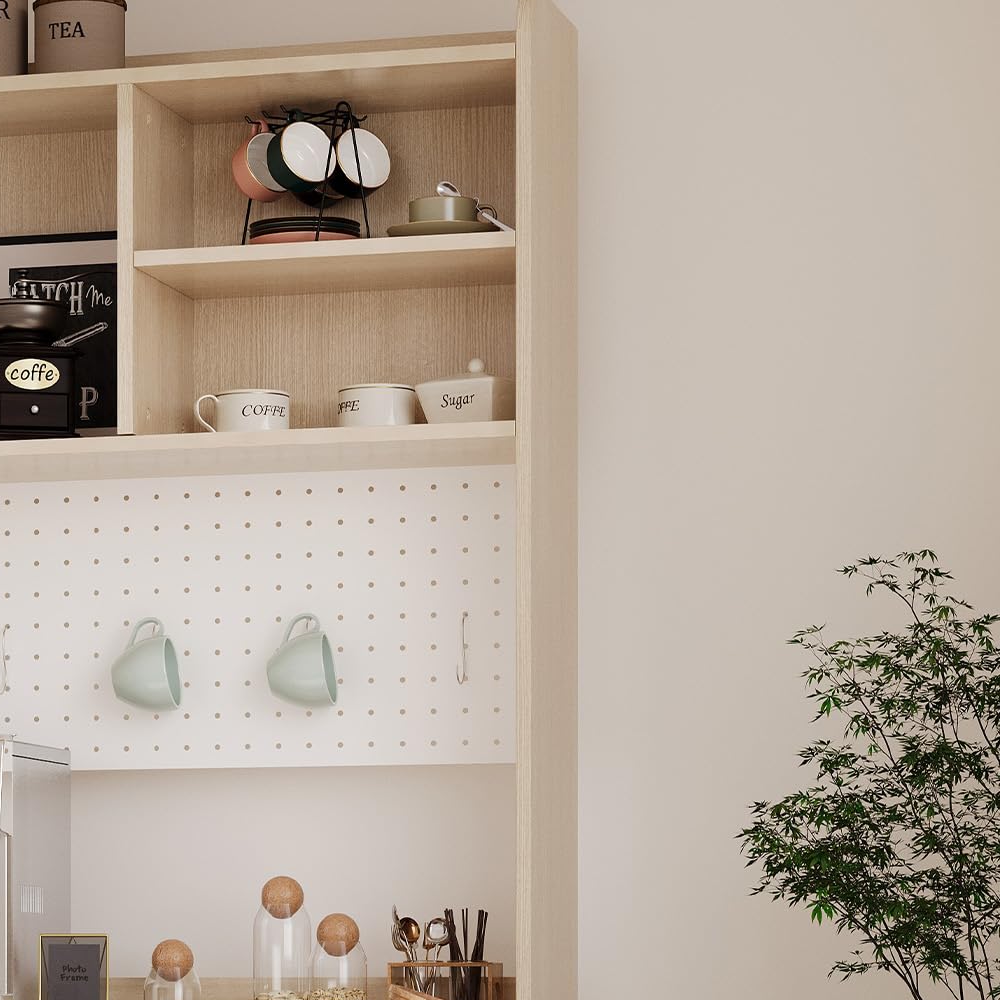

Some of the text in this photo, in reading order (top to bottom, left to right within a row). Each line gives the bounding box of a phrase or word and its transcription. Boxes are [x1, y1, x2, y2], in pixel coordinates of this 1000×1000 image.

[48, 21, 86, 40] TEA
[85, 284, 113, 308] Me
[10, 363, 55, 381] coffe
[440, 392, 475, 410] Sugar
[241, 404, 286, 418] COFFE
[60, 973, 89, 982] Frame
[62, 964, 87, 973] Photo
